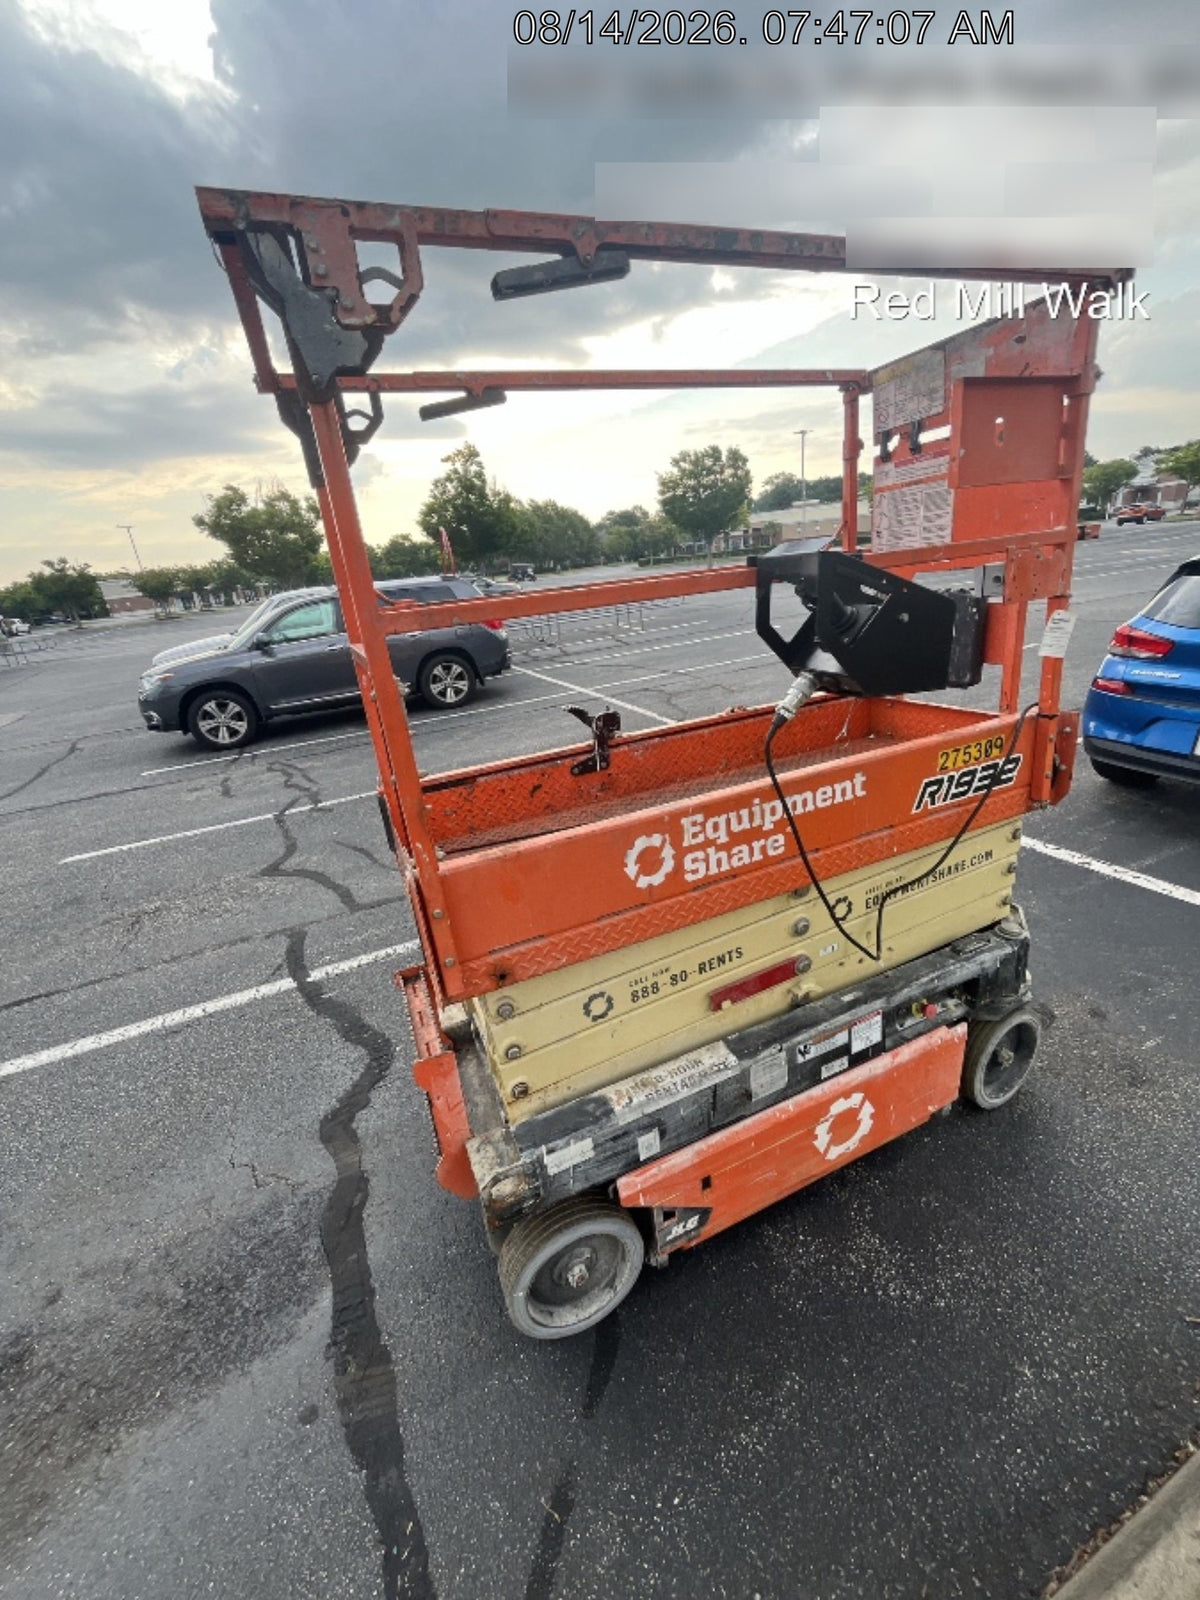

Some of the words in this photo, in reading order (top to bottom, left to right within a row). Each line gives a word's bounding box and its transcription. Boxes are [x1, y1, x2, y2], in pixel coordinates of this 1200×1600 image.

[938, 735, 1005, 772] 275309
[681, 771, 867, 848] Equipment
[683, 827, 786, 883] Share
[630, 946, 744, 1004] 888-80-RENTS
